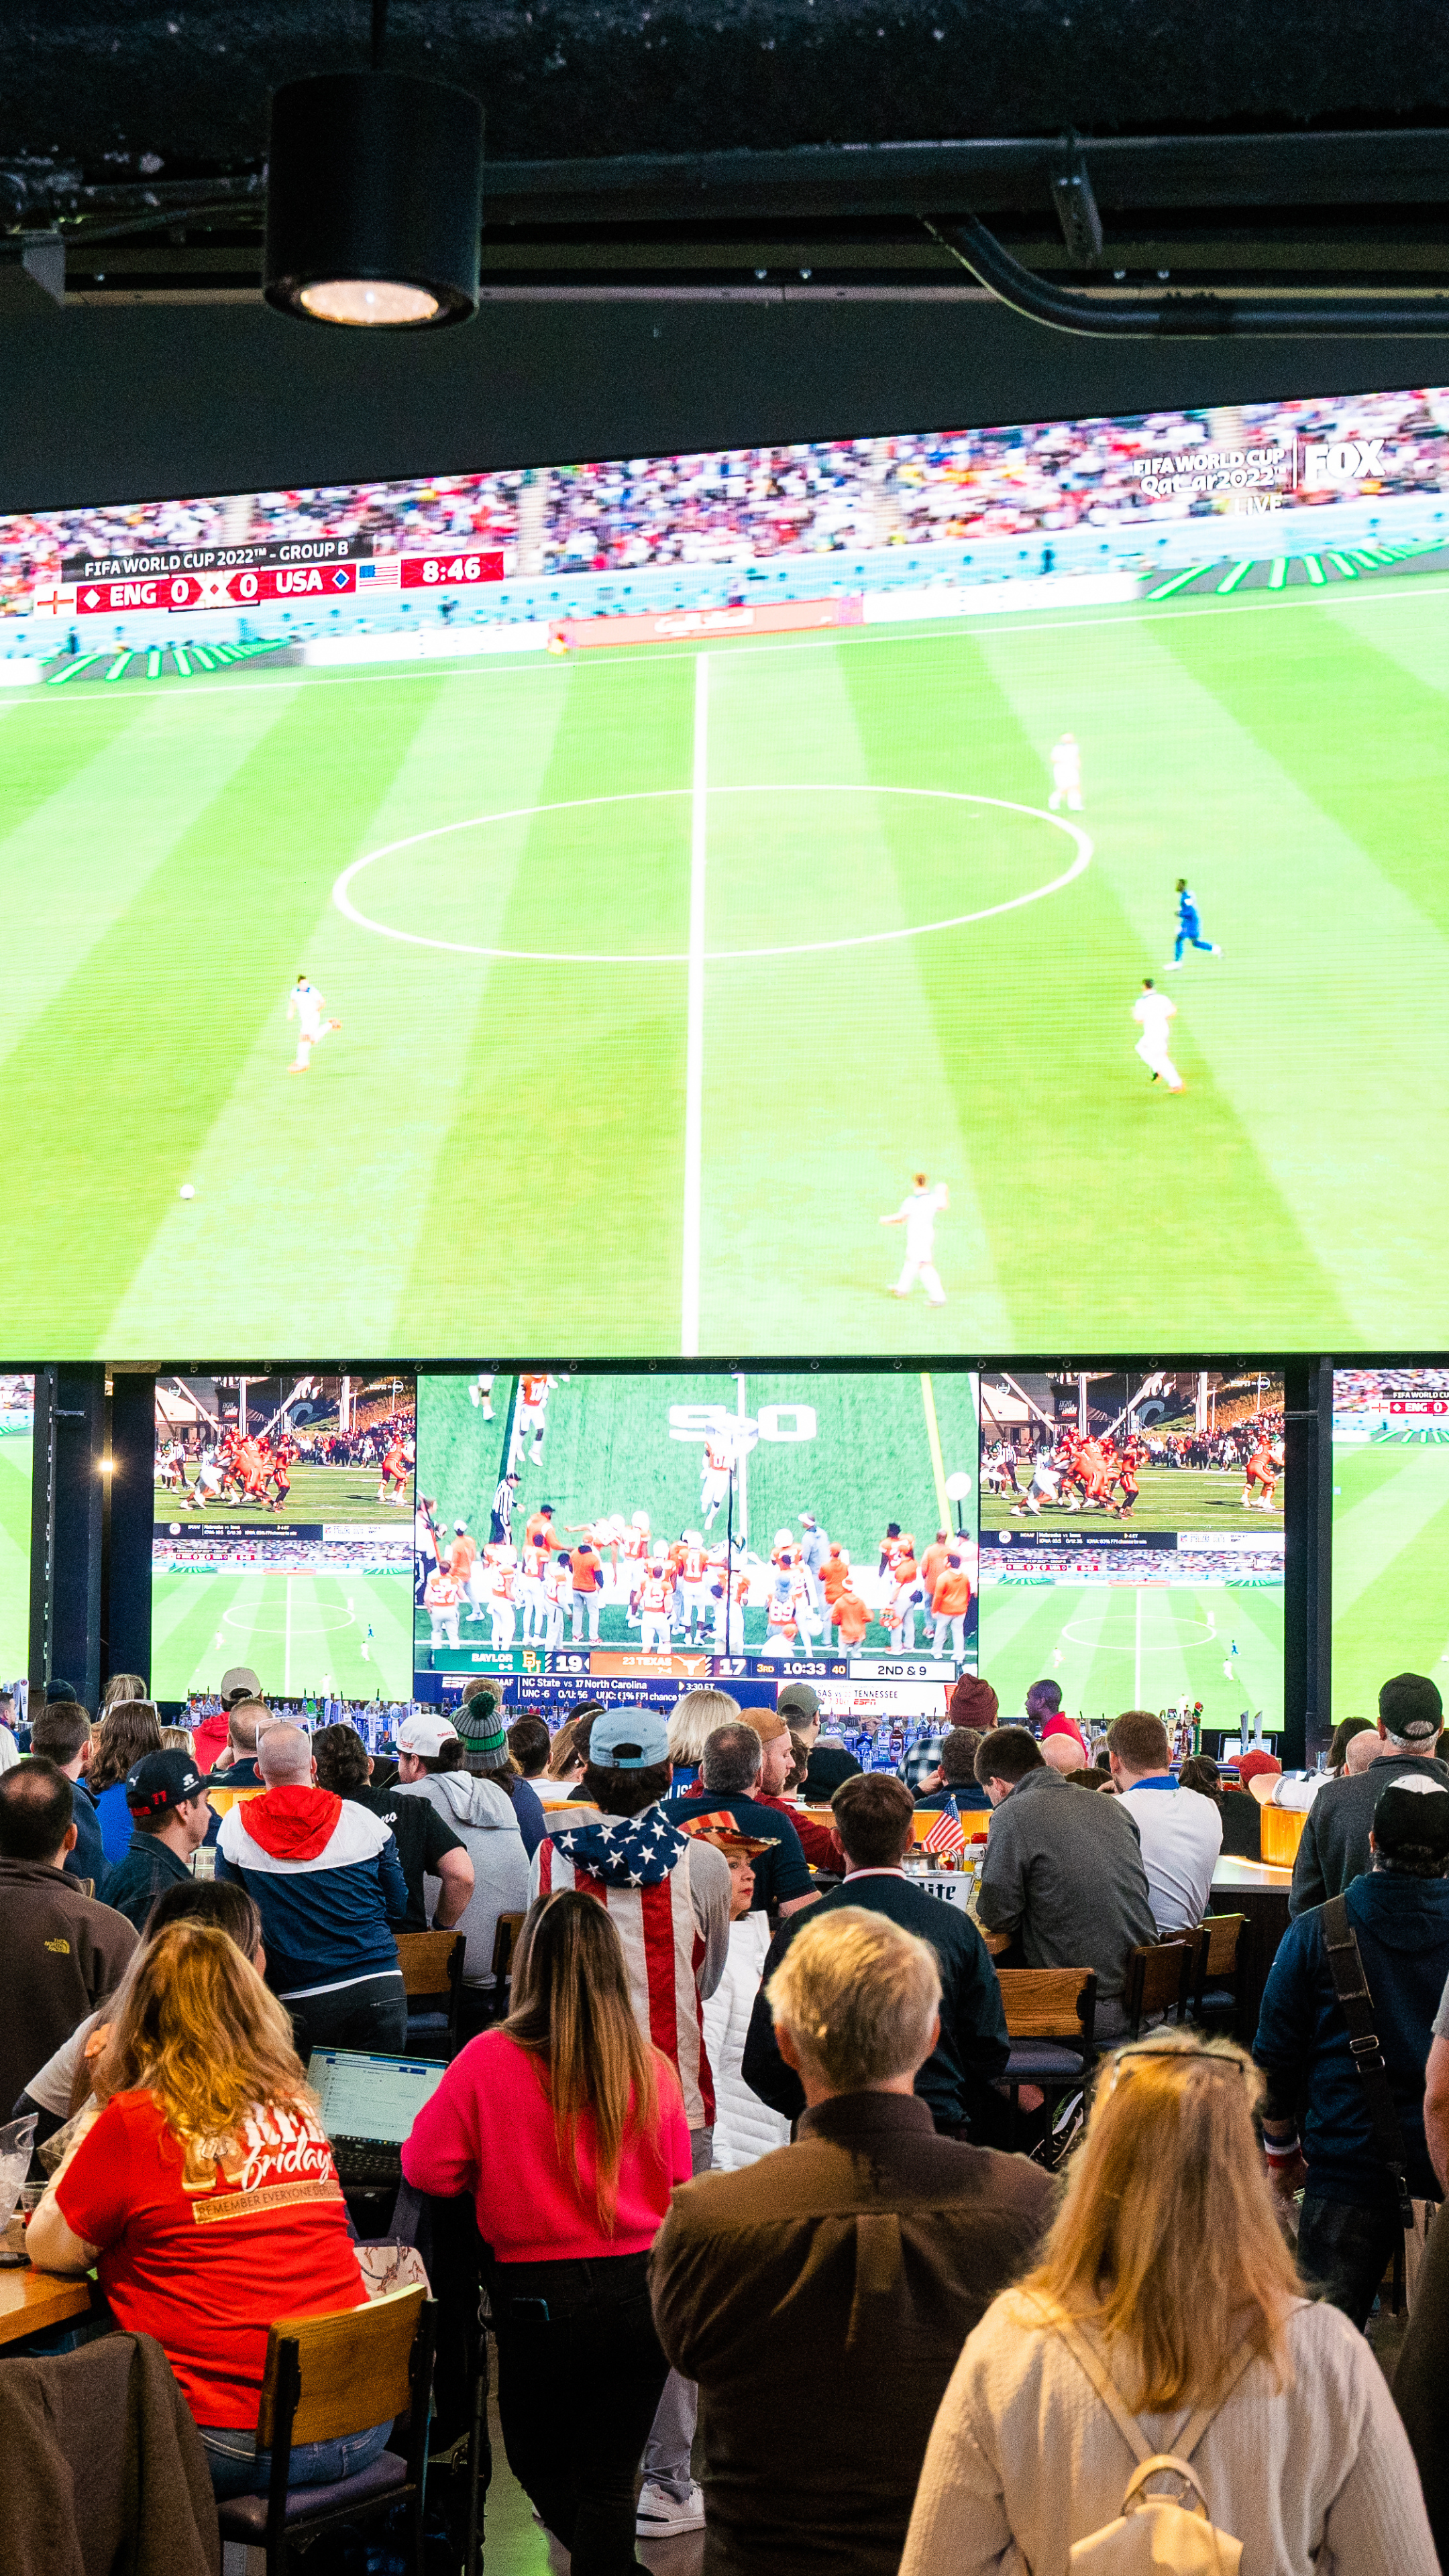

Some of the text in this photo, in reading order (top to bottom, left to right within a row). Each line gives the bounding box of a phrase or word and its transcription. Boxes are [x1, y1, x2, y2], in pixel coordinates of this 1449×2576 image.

[1134, 448, 1285, 476] FIFA WORLD CUP
[1305, 439, 1386, 482] FOX
[1234, 494, 1283, 516] LIVE
[85, 558, 122, 577] FIFA
[122, 554, 180, 574] WORLD
[183, 552, 215, 568] CUP
[280, 543, 334, 561] GROUP
[338, 542, 349, 556] B
[423, 557, 482, 582] 8:46
[109, 569, 323, 606] ENG 0 0 USA
[1405, 1402, 1443, 1412] ENG 0
[472, 1653, 513, 1662] BAYLOR
[555, 1655, 582, 1672] 19
[623, 1657, 672, 1666] 23 TEXAS
[719, 1658, 746, 1675] 17
[757, 1664, 774, 1673] 3RD
[783, 1662, 826, 1675] 10:33
[831, 1665, 846, 1674] 40
[877, 1666, 926, 1676] 2ND & 9
[522, 1678, 536, 1686] NC
[537, 1678, 560, 1687] State
[584, 1680, 609, 1688] North
[610, 1680, 647, 1689] Carolina
[686, 1682, 703, 1690] 3:30
[522, 1690, 540, 1698] UNC
[854, 1690, 898, 1699] TENNESSEE
[200, 2196, 261, 2216] REMEMBER
[262, 2185, 314, 2205] EVERYONE
